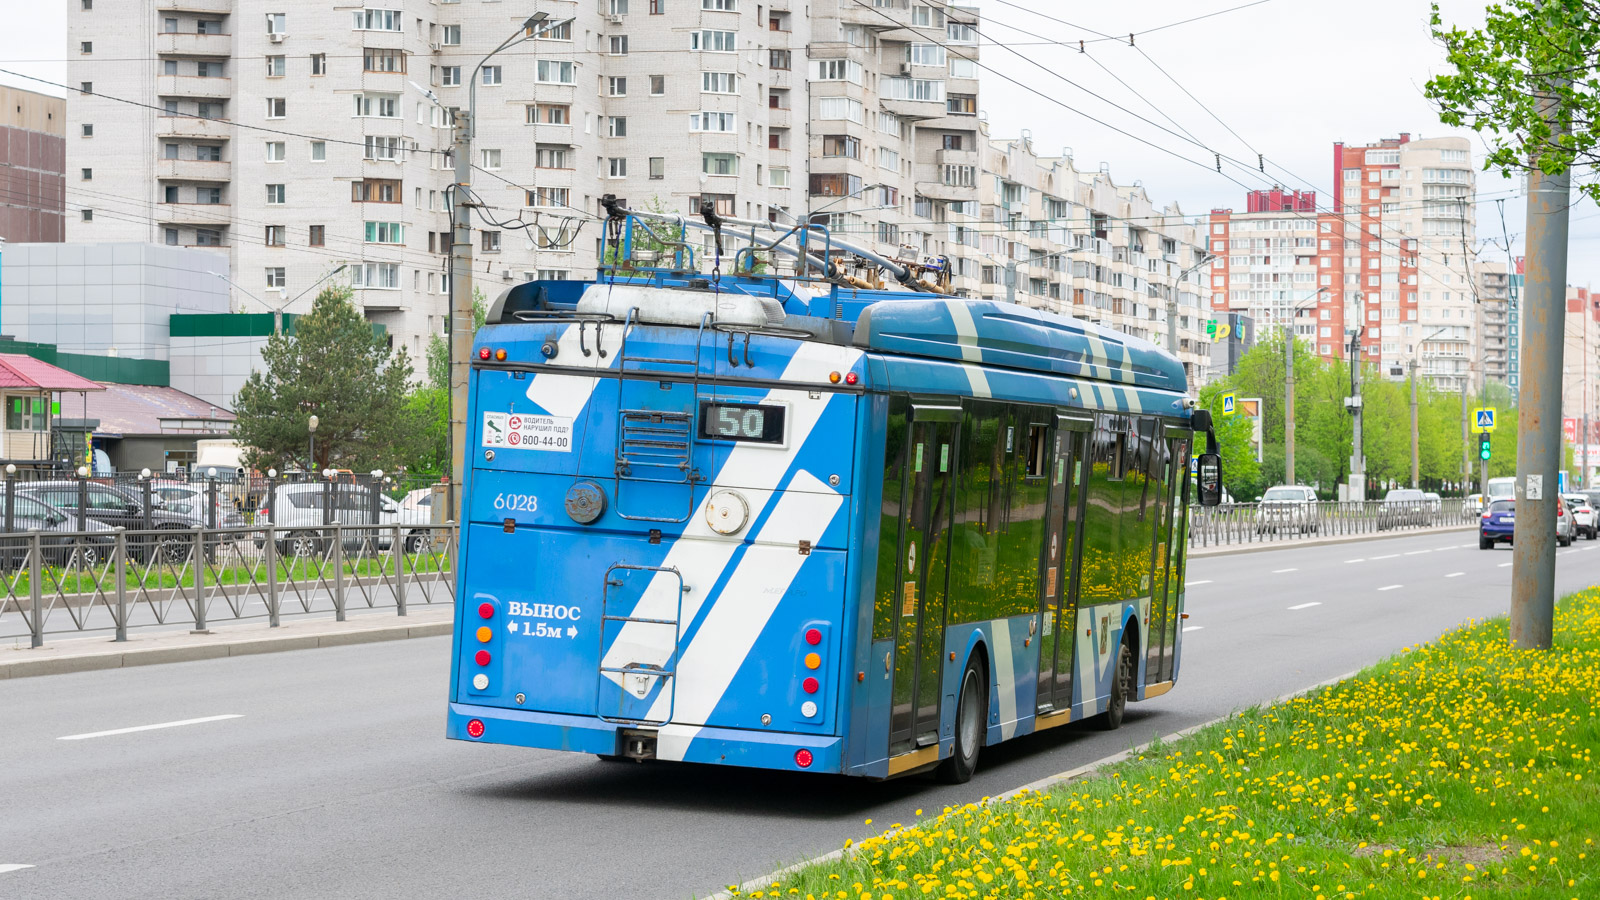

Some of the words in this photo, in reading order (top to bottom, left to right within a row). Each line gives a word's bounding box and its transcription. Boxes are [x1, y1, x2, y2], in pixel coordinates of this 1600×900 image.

[719, 407, 764, 437] 50
[522, 435, 568, 447] 600-44-00
[493, 493, 538, 512] 6028
[508, 601, 581, 621] ВЫНОС
[522, 621, 562, 639] 1.5м
